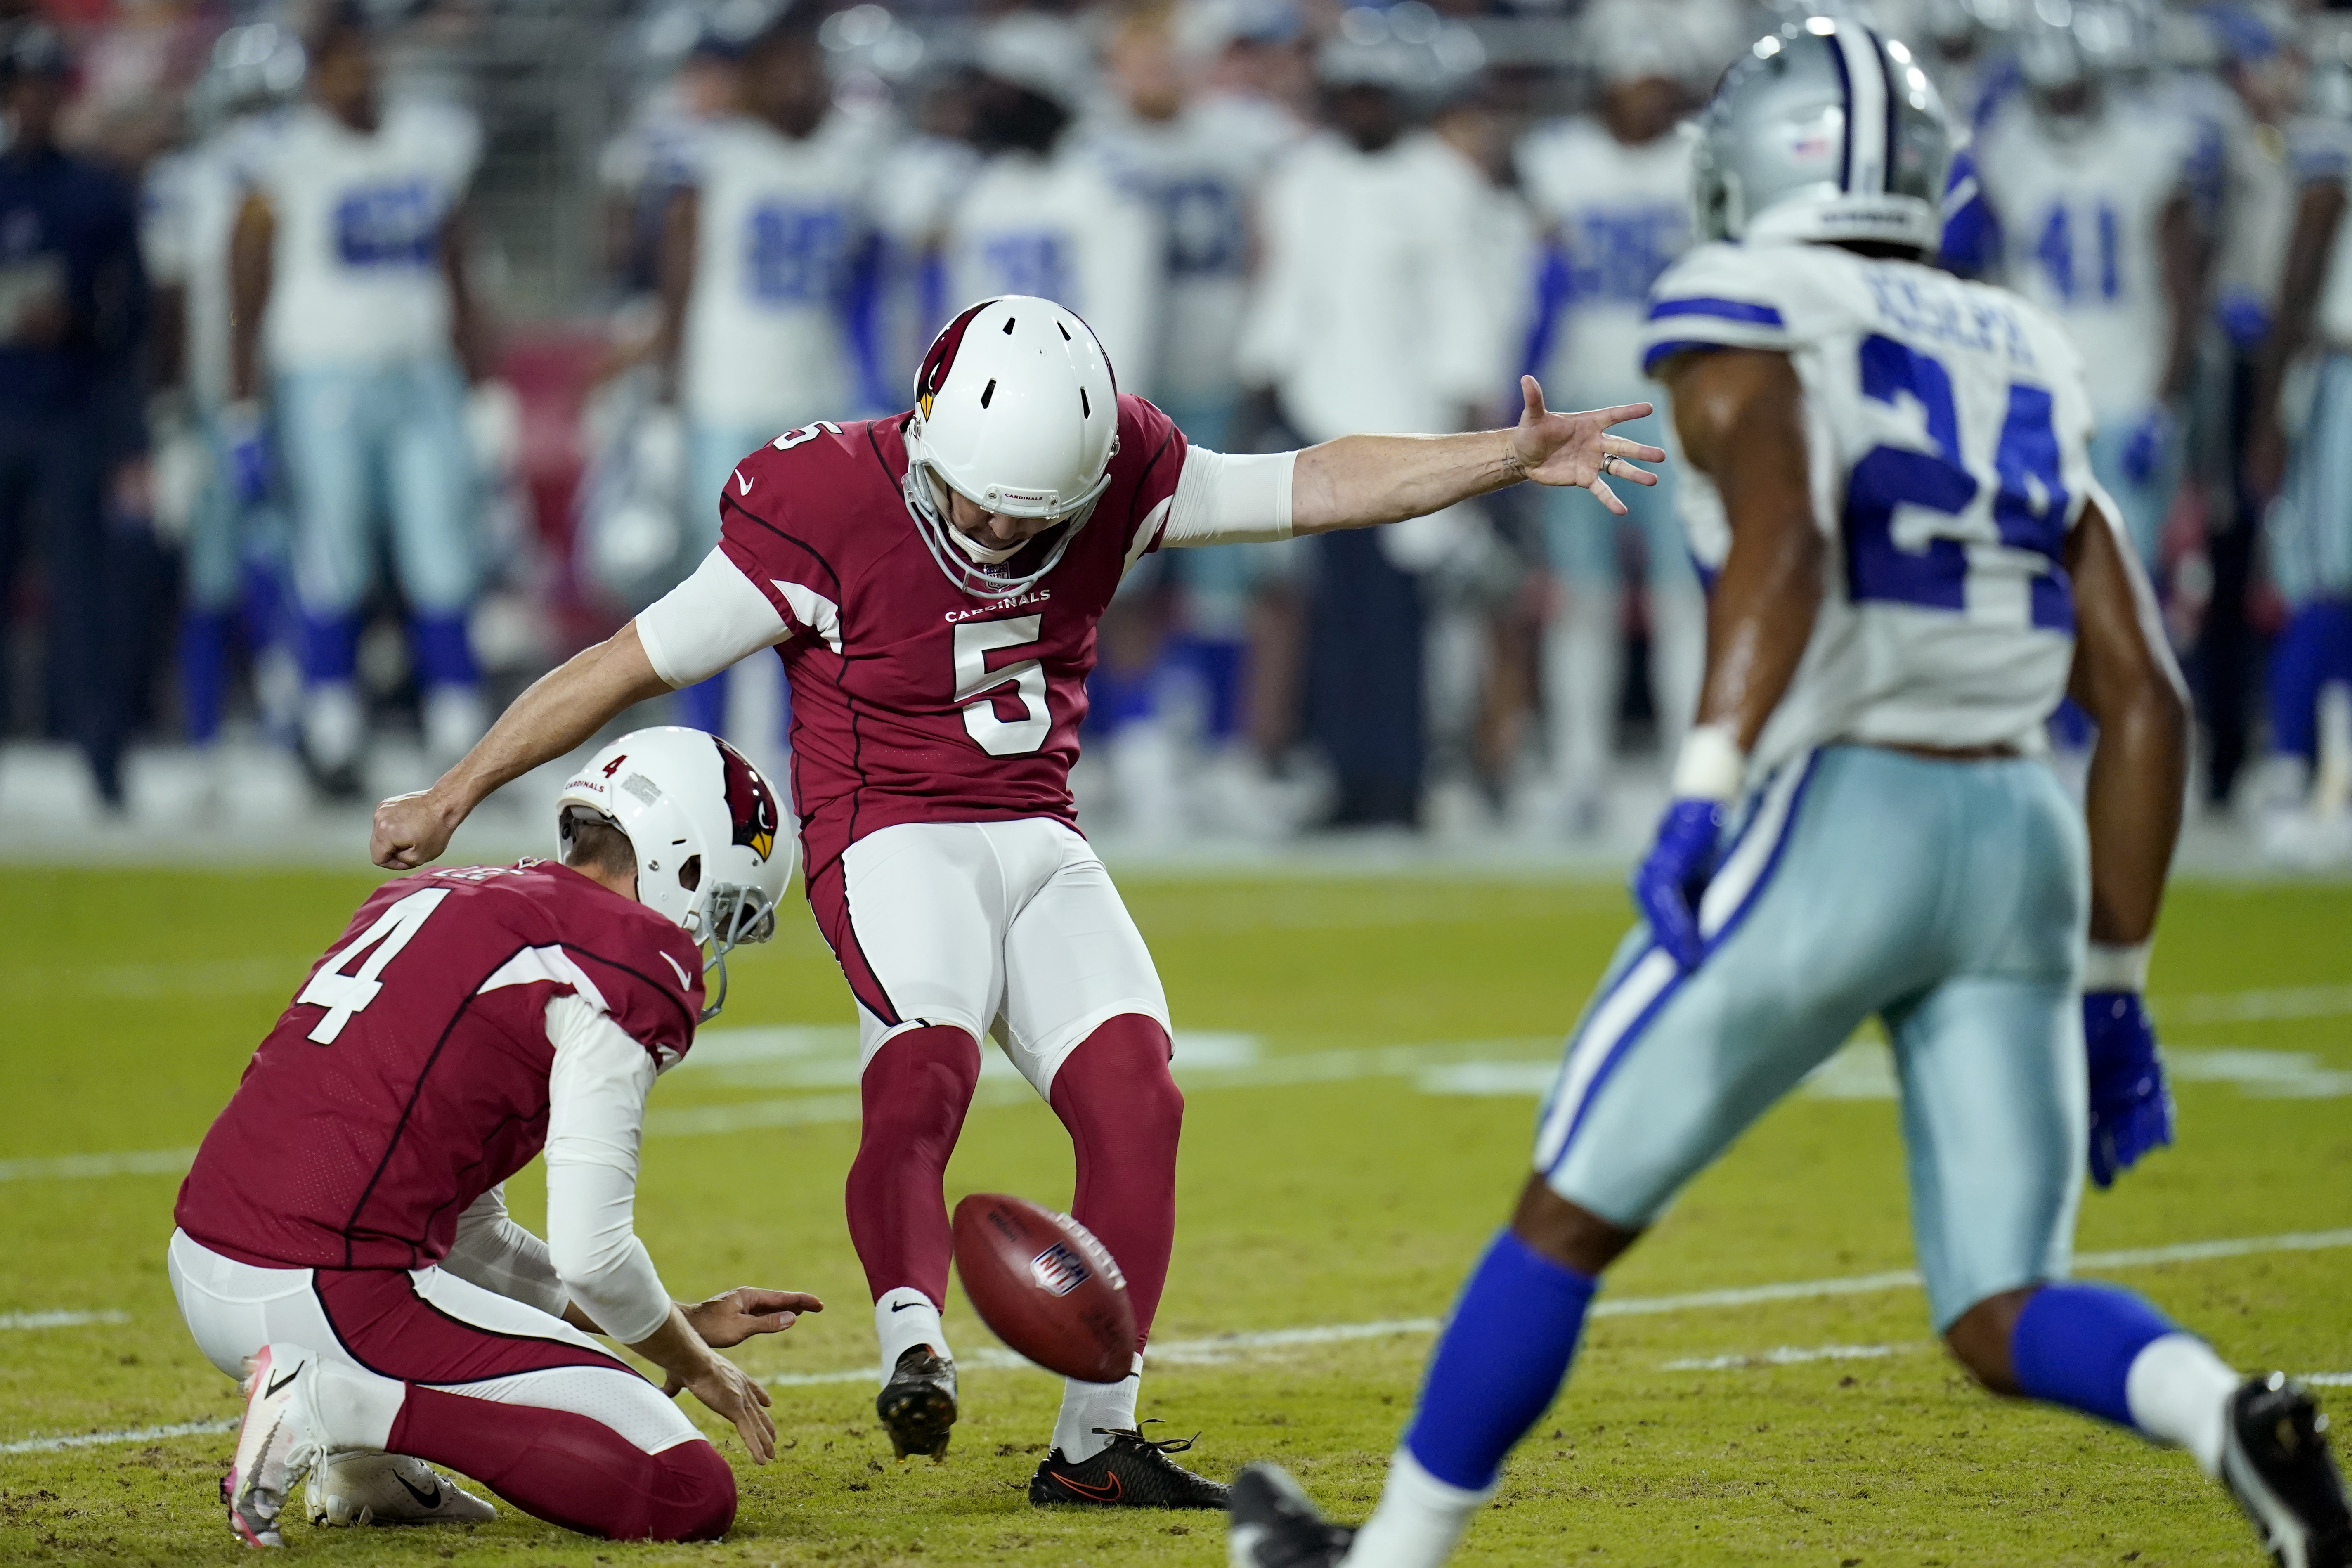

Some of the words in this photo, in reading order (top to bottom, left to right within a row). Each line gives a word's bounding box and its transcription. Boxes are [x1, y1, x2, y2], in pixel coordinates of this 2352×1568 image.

[1846, 333, 2076, 636] 24
[945, 589, 1051, 622] CARDINALS
[953, 613, 1052, 757] 5
[565, 781, 604, 792] CARDINALS
[602, 755, 628, 778] 4
[296, 887, 452, 1045] 4
